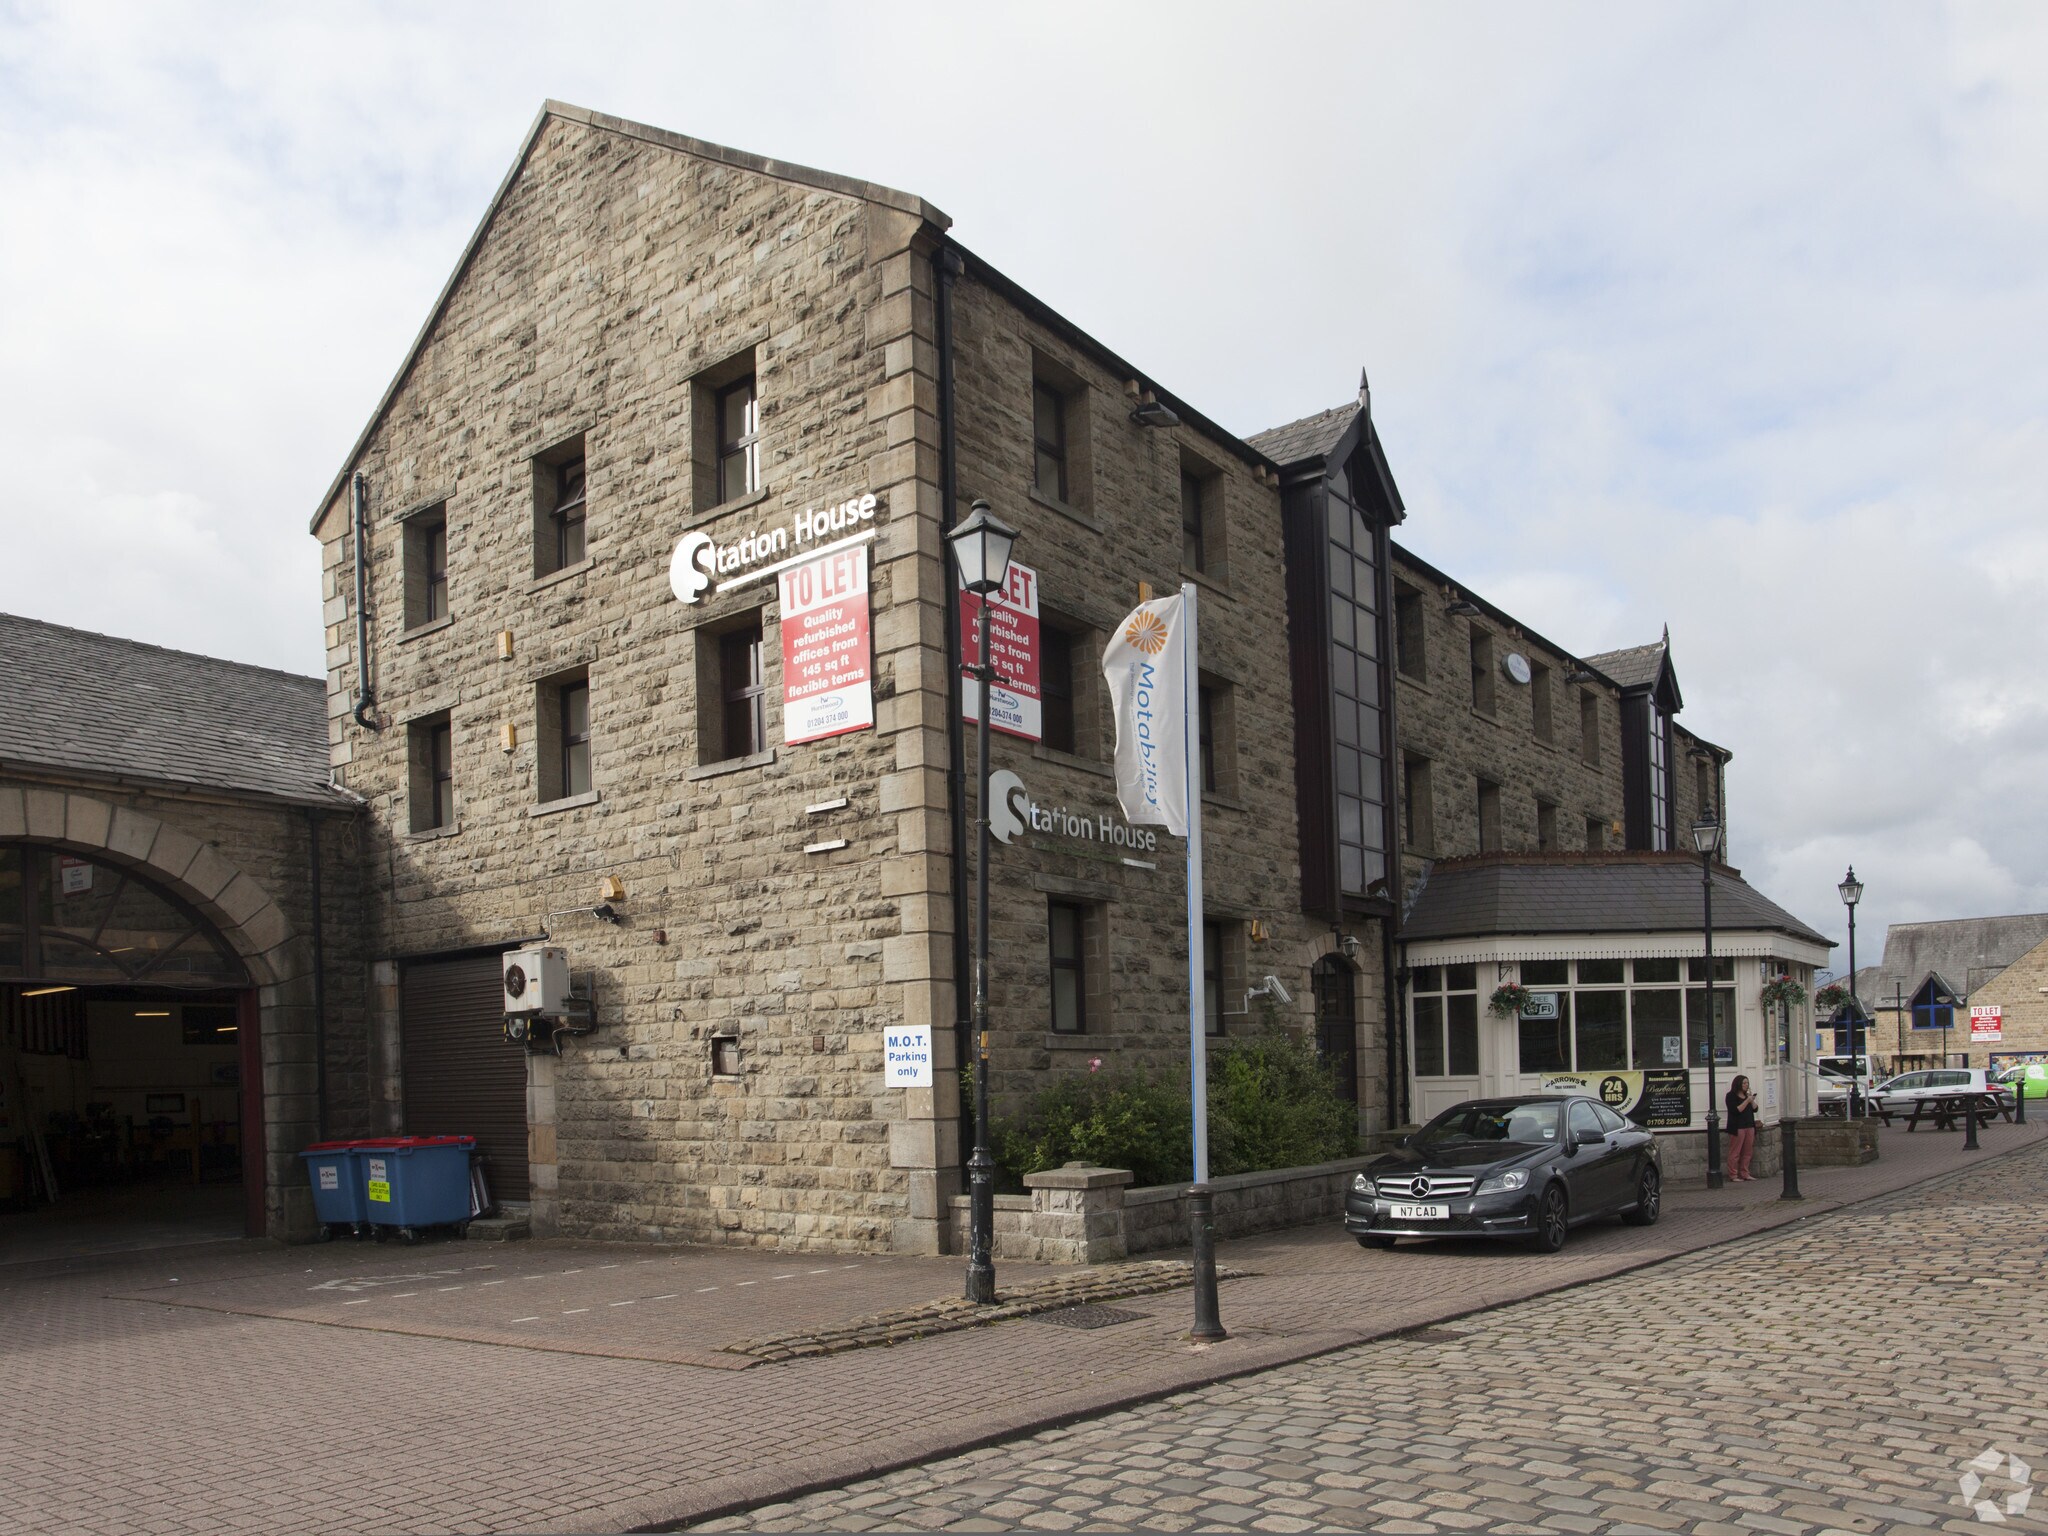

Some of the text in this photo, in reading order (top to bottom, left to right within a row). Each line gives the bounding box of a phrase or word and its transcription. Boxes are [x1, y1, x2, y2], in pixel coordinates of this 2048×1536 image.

[670, 493, 876, 603] Station House
[785, 548, 861, 610] TO LET
[999, 566, 1032, 610] ET
[803, 608, 843, 628] Quality
[990, 609, 1018, 628] uality
[793, 618, 856, 648] refurbished
[792, 637, 858, 665] offices from
[1007, 645, 1032, 662] from
[802, 654, 850, 677] 145 sq ft
[1001, 660, 1014, 674] sq
[1016, 663, 1025, 675] ft
[788, 668, 865, 698] flexible terms
[1008, 676, 1037, 695] terms
[1137, 662, 1157, 805] Motability
[989, 769, 1157, 852] Station House
[1973, 1006, 1999, 1016] TO LET
[888, 1035, 927, 1048] M.O.T.
[888, 1051, 927, 1063] Parking
[897, 1066, 919, 1078] only
[1550, 1076, 1580, 1086] ARROWS
[1604, 1080, 1623, 1093] 24
[1604, 1093, 1624, 1102] HRS
[1646, 1118, 1665, 1126] 01706
[1400, 1206, 1437, 1217] N7 CAD
